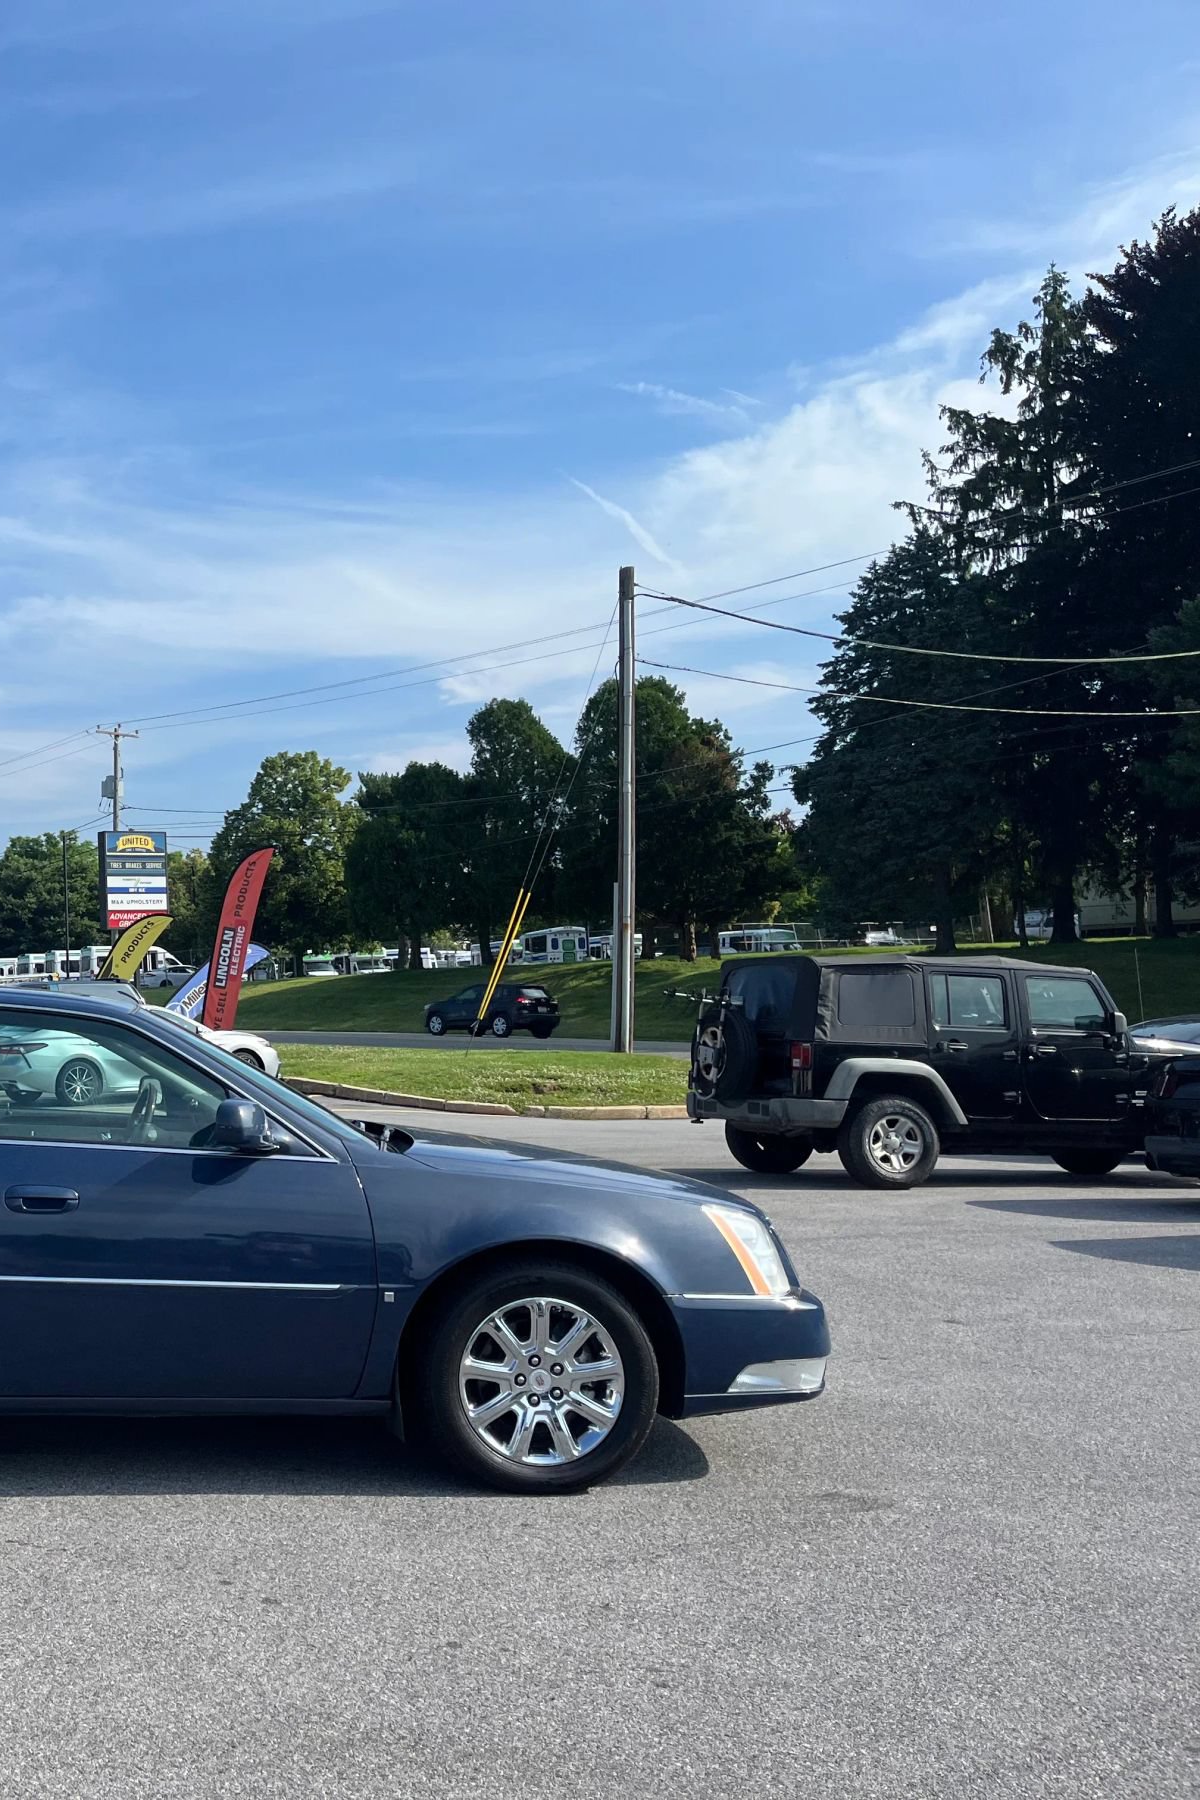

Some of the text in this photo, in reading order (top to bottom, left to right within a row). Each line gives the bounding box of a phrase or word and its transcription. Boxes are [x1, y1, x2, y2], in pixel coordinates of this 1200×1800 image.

[122, 837, 149, 846] UNITED
[234, 861, 256, 918] PRODUCTS
[121, 920, 154, 963] PRODUCTS
[215, 930, 234, 987] LINCOLN
[230, 925, 245, 975] ELECTRIC
[216, 991, 227, 1014] SELL
